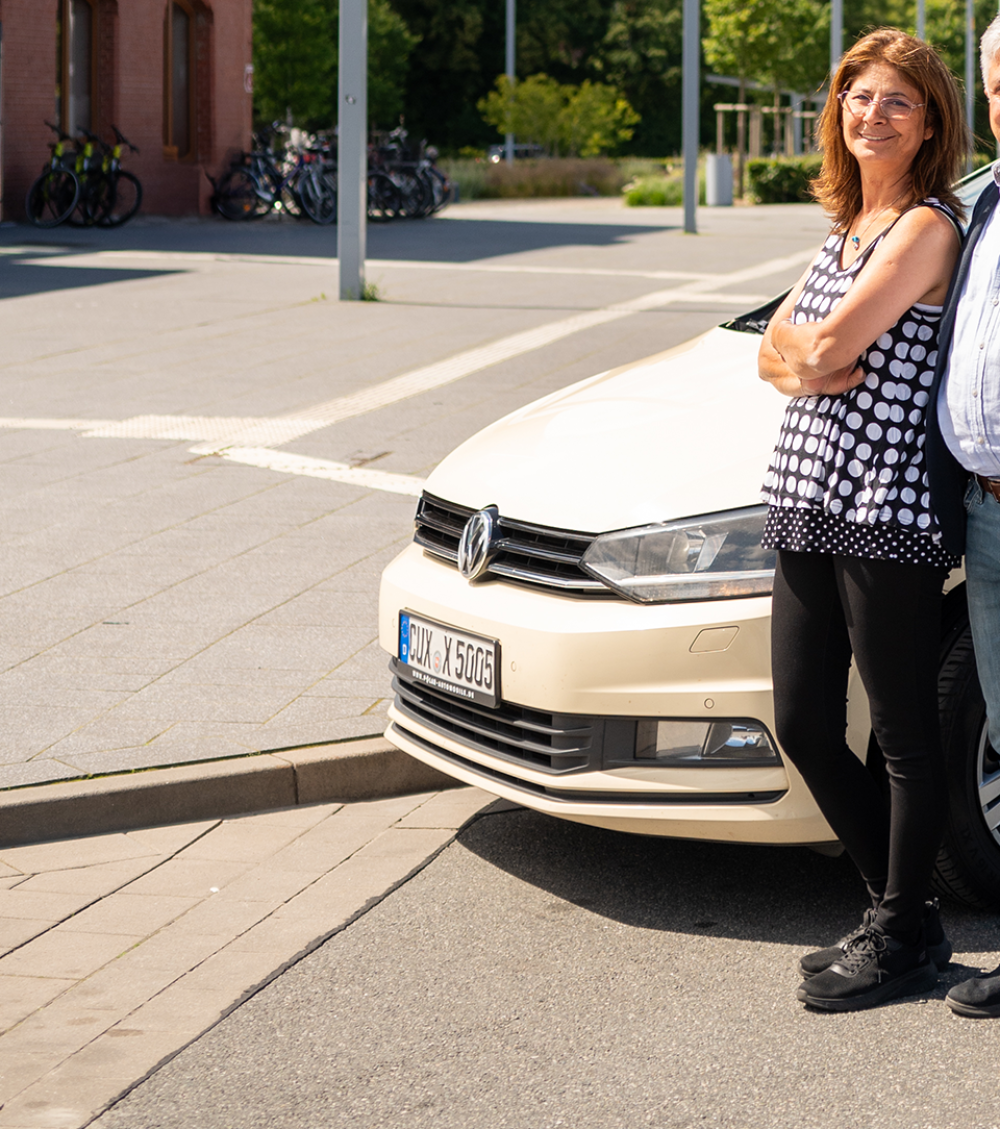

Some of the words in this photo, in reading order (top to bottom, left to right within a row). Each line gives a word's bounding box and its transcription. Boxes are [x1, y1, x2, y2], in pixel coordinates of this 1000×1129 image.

[409, 623, 433, 669] CUX
[442, 635, 452, 676] X
[455, 639, 494, 690] 5005
